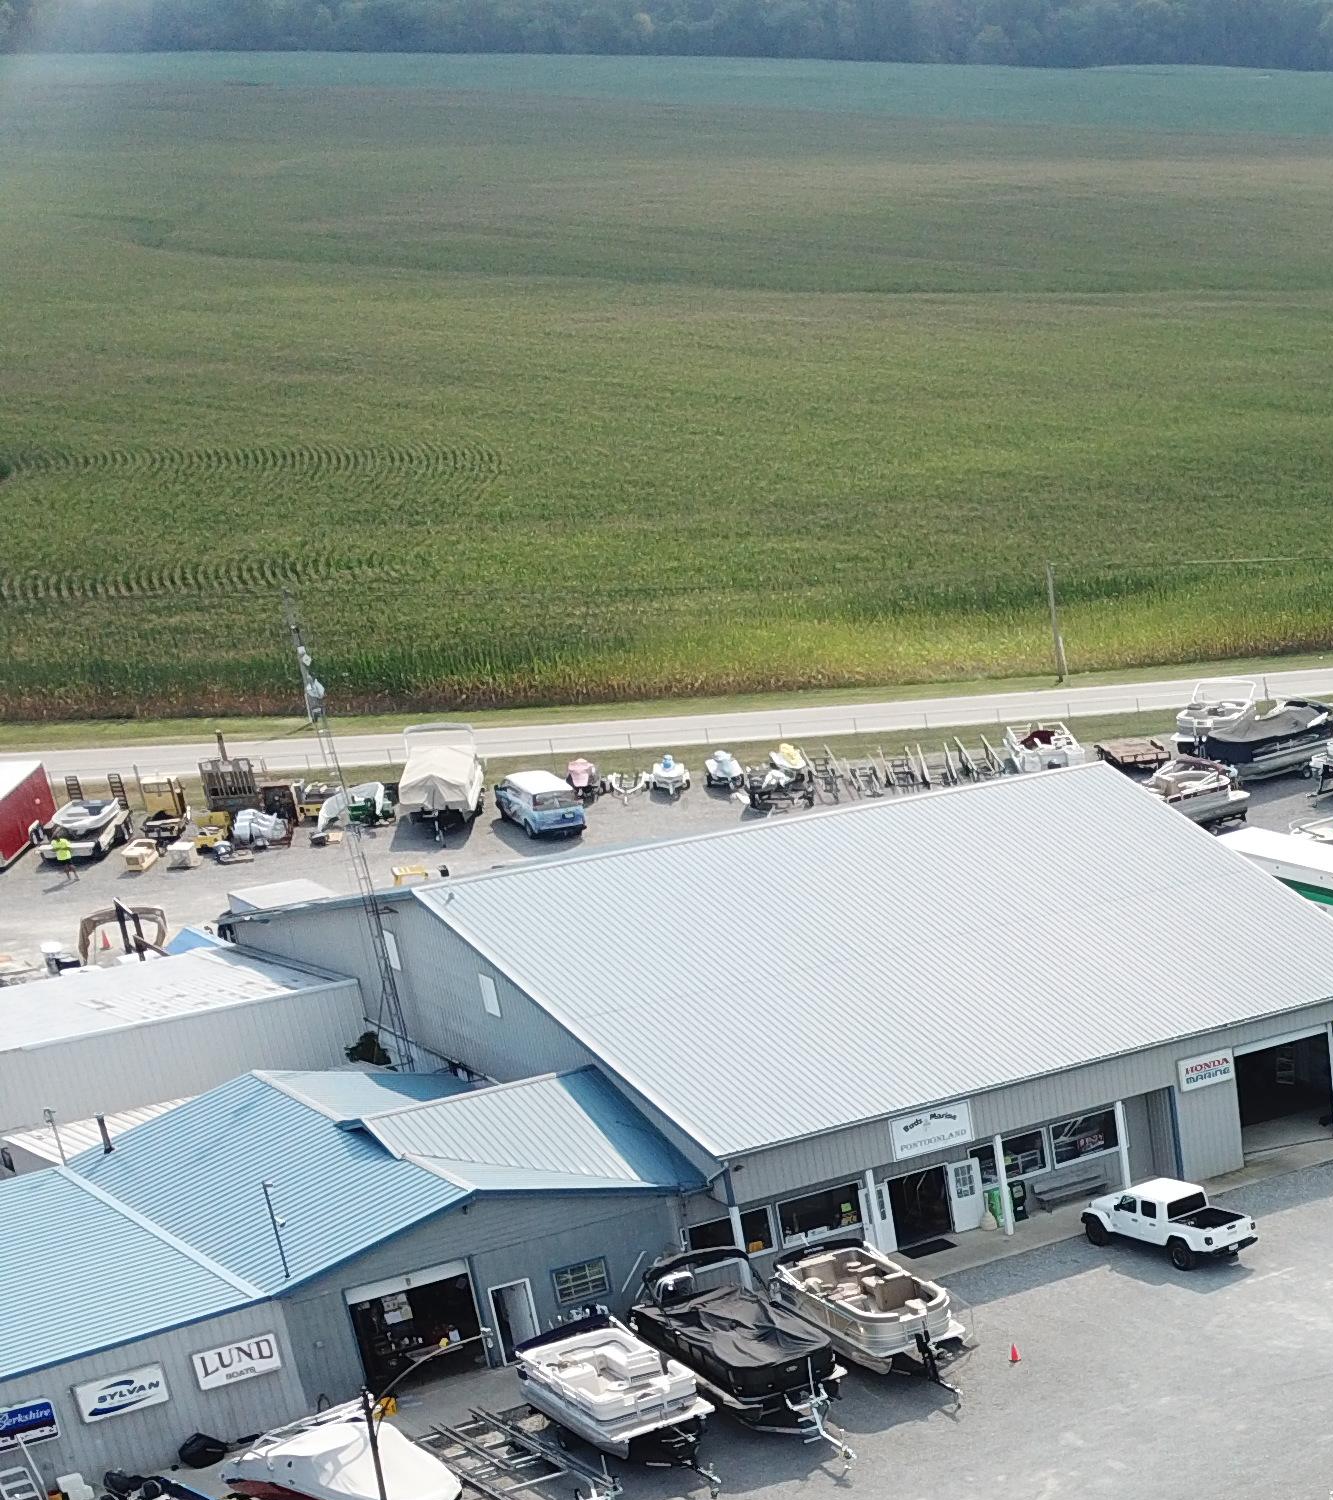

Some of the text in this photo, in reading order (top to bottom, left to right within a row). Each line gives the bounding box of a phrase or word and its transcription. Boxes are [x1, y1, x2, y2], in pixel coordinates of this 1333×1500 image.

[1185, 1057, 1230, 1075] HONDA
[901, 1129, 967, 1153] PONTOONLAND
[199, 1338, 275, 1378] LUND
[224, 1365, 257, 1381] BOATS
[97, 1380, 160, 1404] SYLVAN
